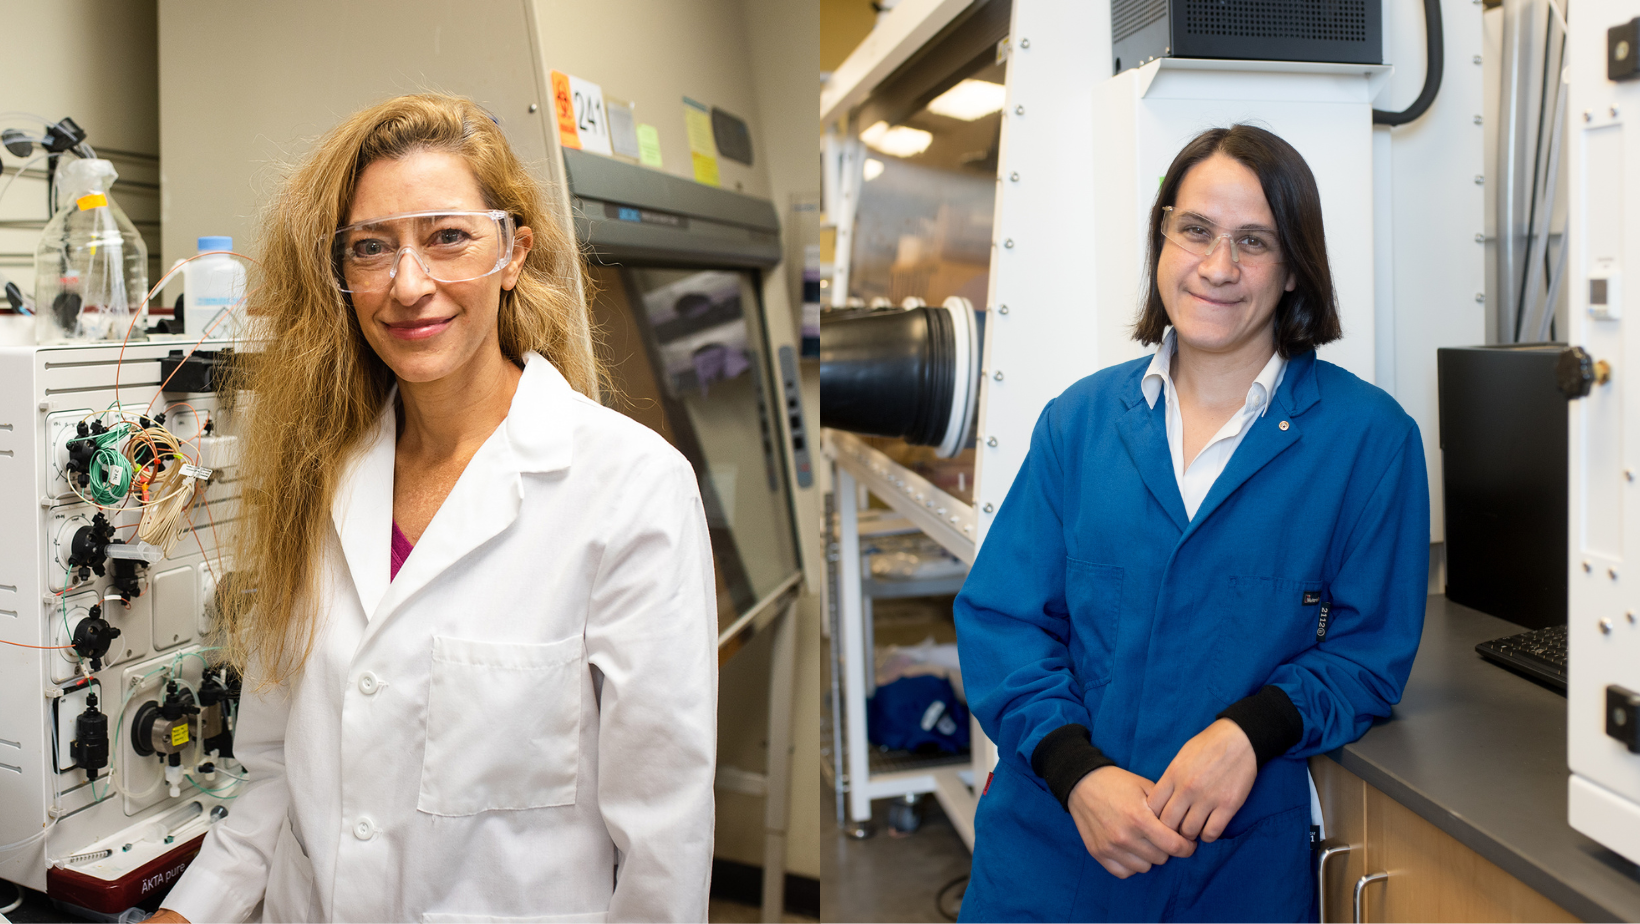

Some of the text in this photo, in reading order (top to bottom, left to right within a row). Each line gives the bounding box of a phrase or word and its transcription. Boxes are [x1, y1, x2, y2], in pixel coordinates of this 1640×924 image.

[574, 91, 605, 137] 241
[1318, 607, 1329, 628] 2112
[141, 862, 185, 895] ÄKTA pure
